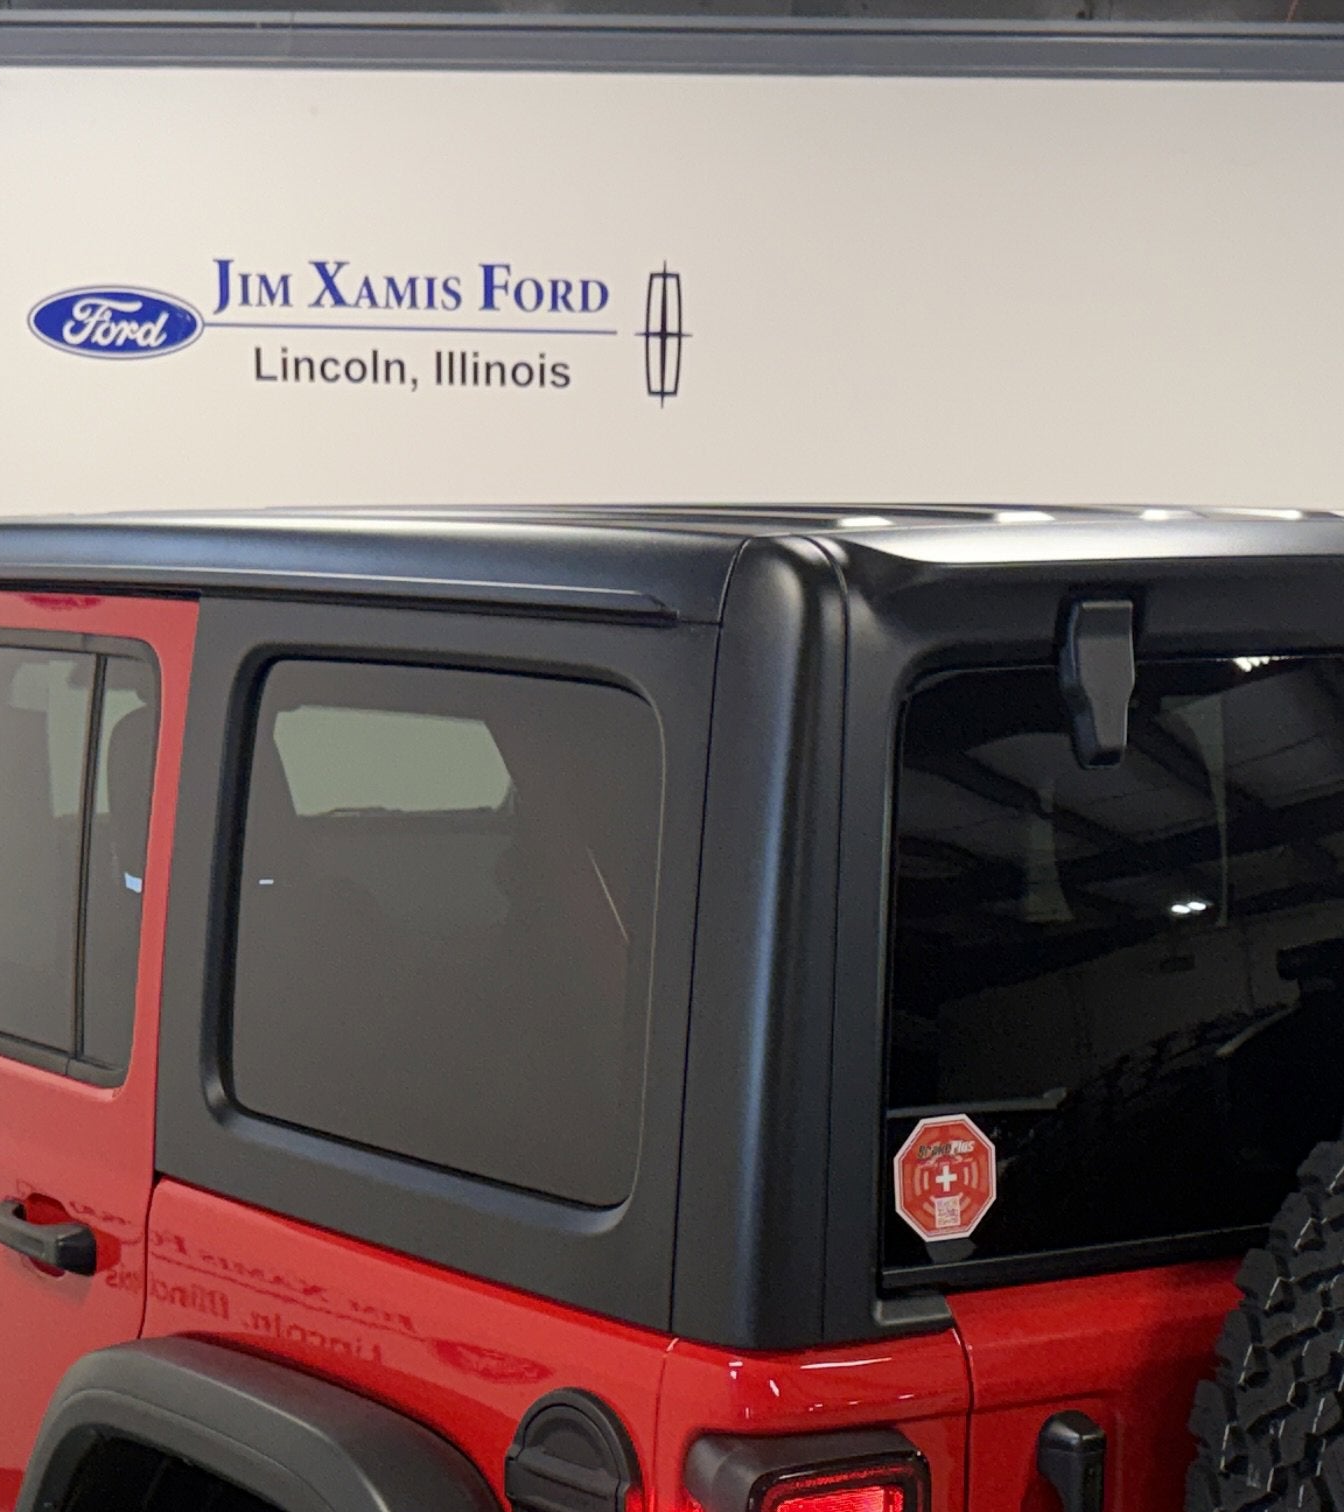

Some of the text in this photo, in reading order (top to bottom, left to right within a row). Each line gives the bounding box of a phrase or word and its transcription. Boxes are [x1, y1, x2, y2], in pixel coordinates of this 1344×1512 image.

[213, 259, 609, 314] JIM XAMIS FORD
[61, 296, 167, 350] Ford
[255, 347, 571, 391] Lincoln, Illinois
